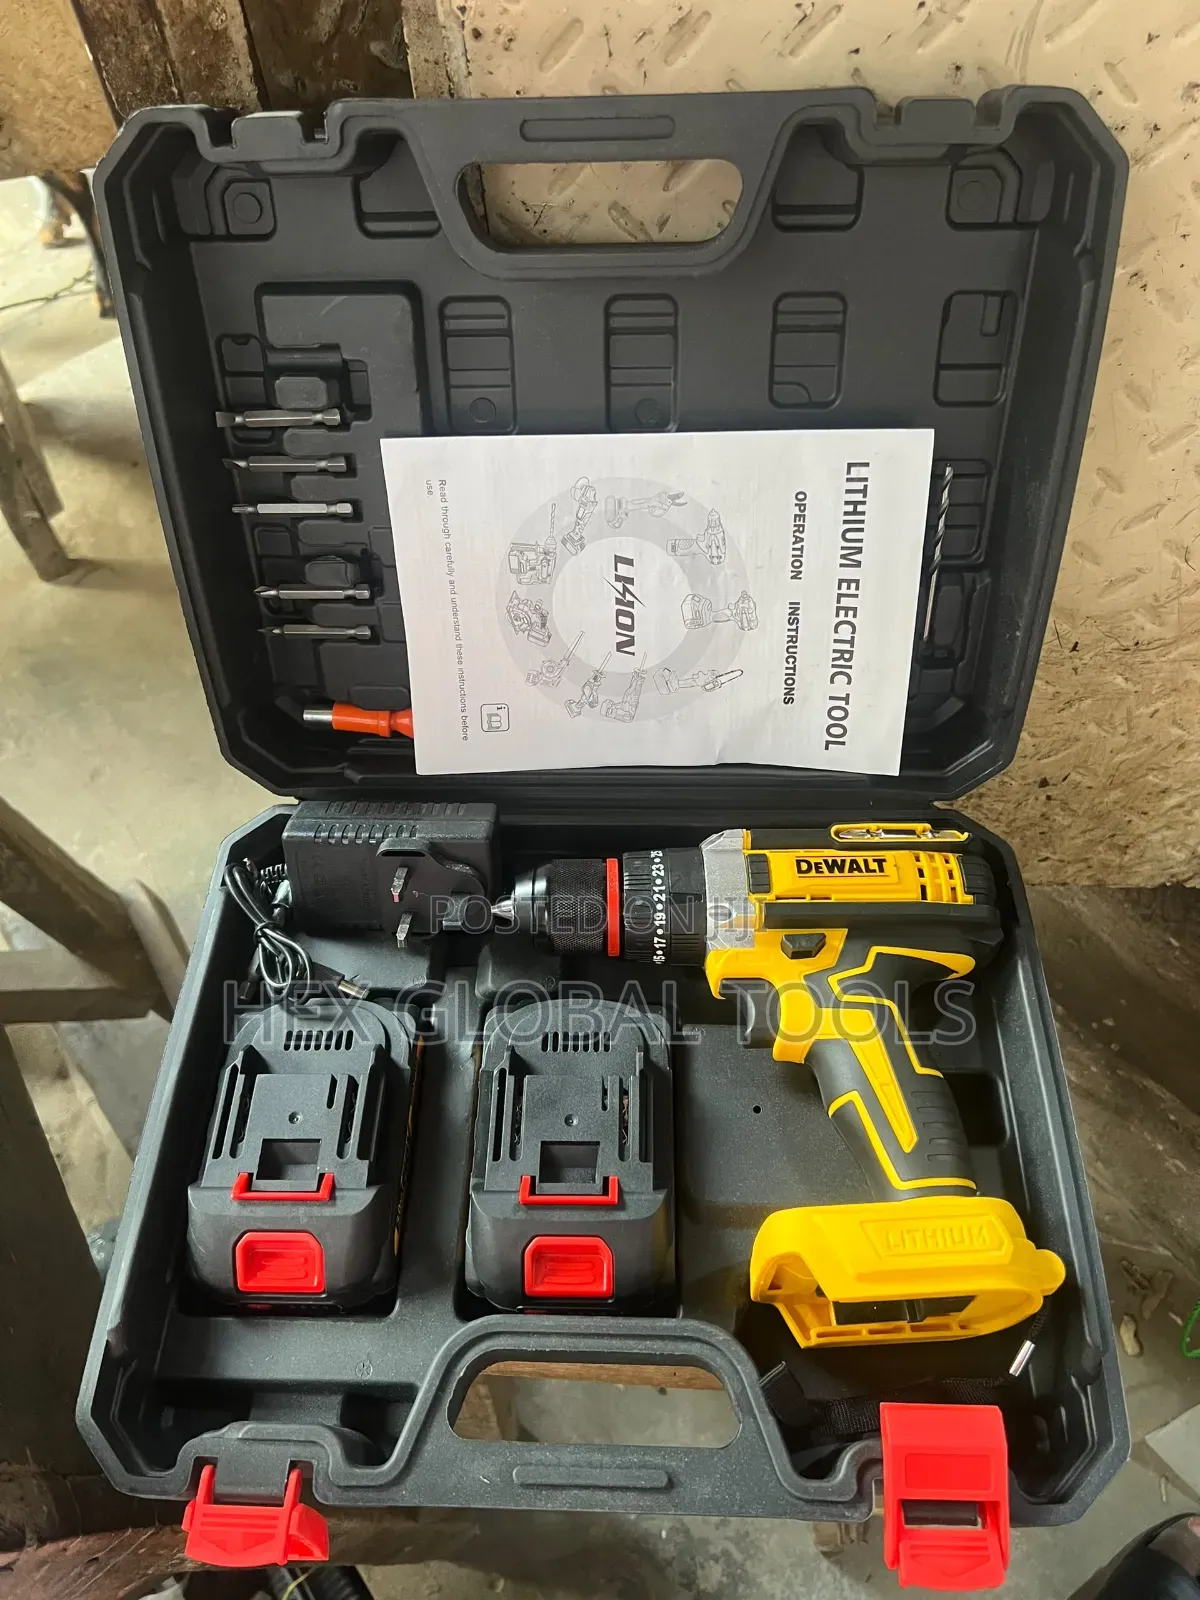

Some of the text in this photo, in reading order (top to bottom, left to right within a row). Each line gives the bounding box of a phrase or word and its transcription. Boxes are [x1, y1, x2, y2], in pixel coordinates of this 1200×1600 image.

[782, 490, 808, 706] OPERATION INSTRUCTIONS
[824, 461, 871, 751] LITHIUM ELECTRIC TOOL
[438, 479, 470, 742] Read through carefully and understand these instructions before
[651, 863, 665, 877] 23
[652, 885, 666, 902] 21
[653, 912, 667, 927] 19
[653, 936, 667, 949] 17
[885, 1224, 991, 1252] LITHIUM
